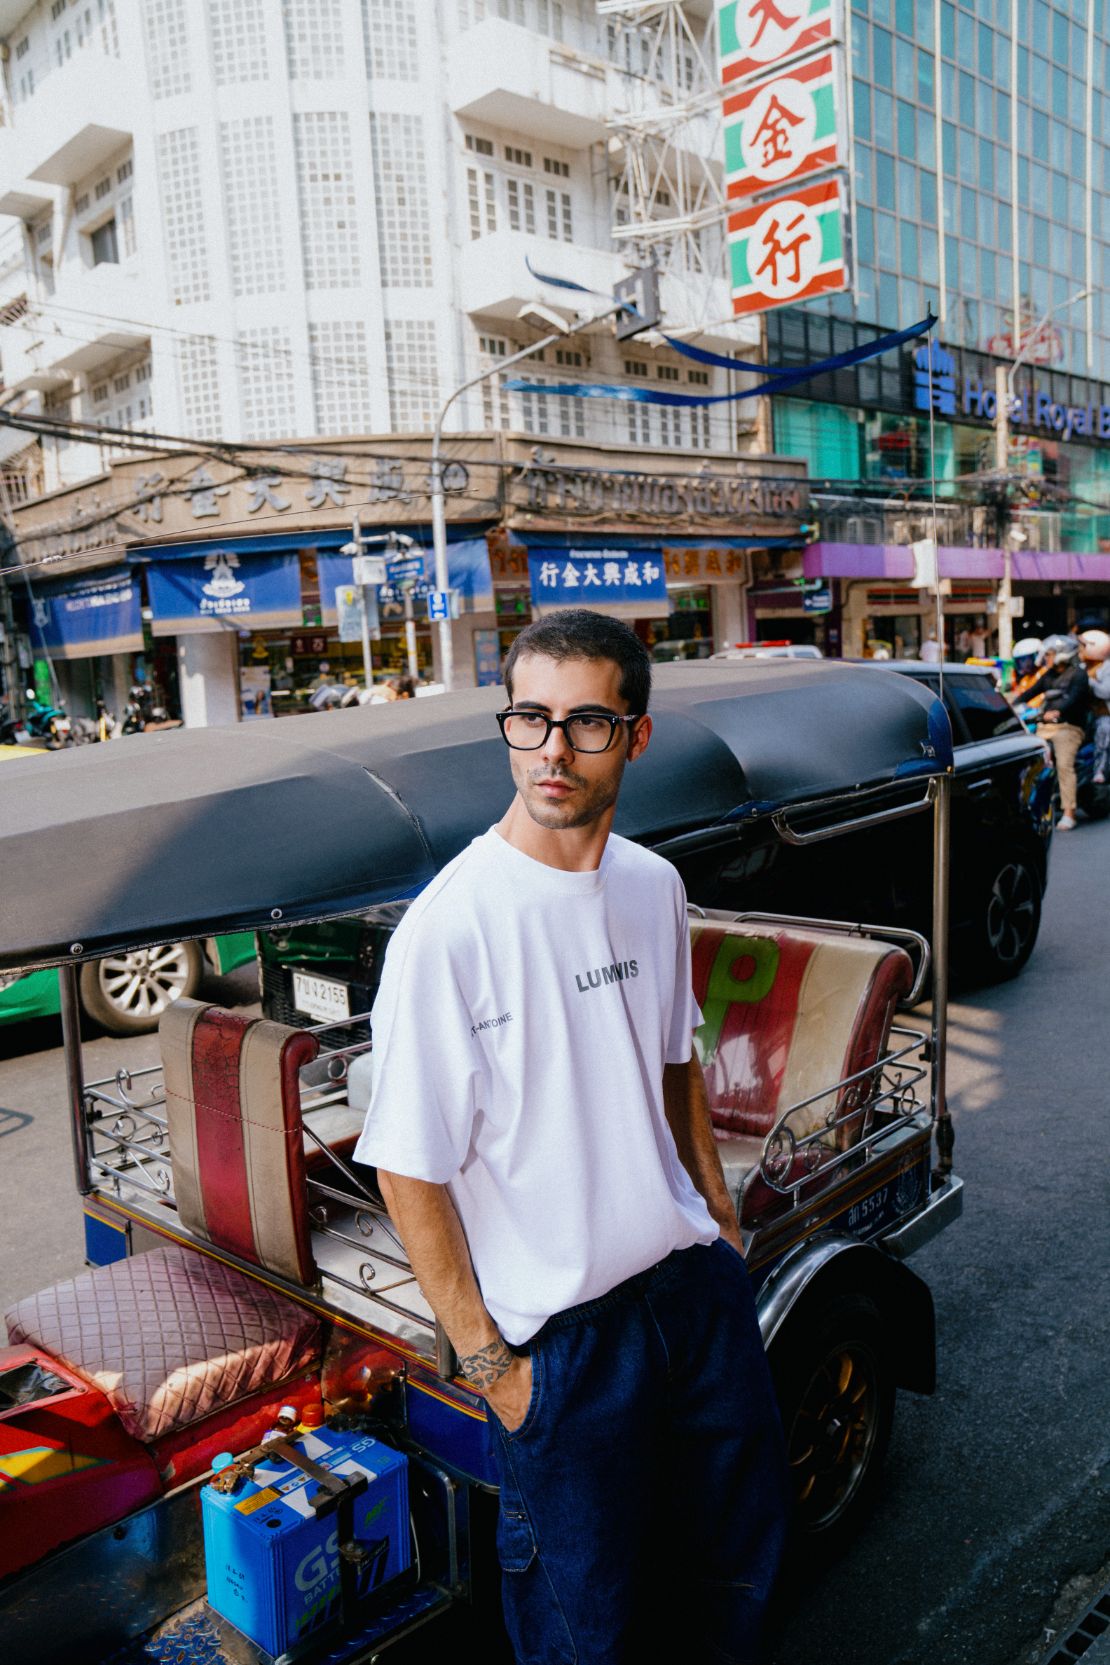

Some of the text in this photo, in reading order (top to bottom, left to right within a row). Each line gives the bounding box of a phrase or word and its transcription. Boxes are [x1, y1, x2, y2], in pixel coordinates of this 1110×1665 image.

[964, 376, 1029, 425] Hoel
[1035, 390, 1094, 442] Royal
[320, 983, 345, 1005] 2155
[861, 1187, 888, 1217] 5537
[351, 1437, 376, 1453] GS
